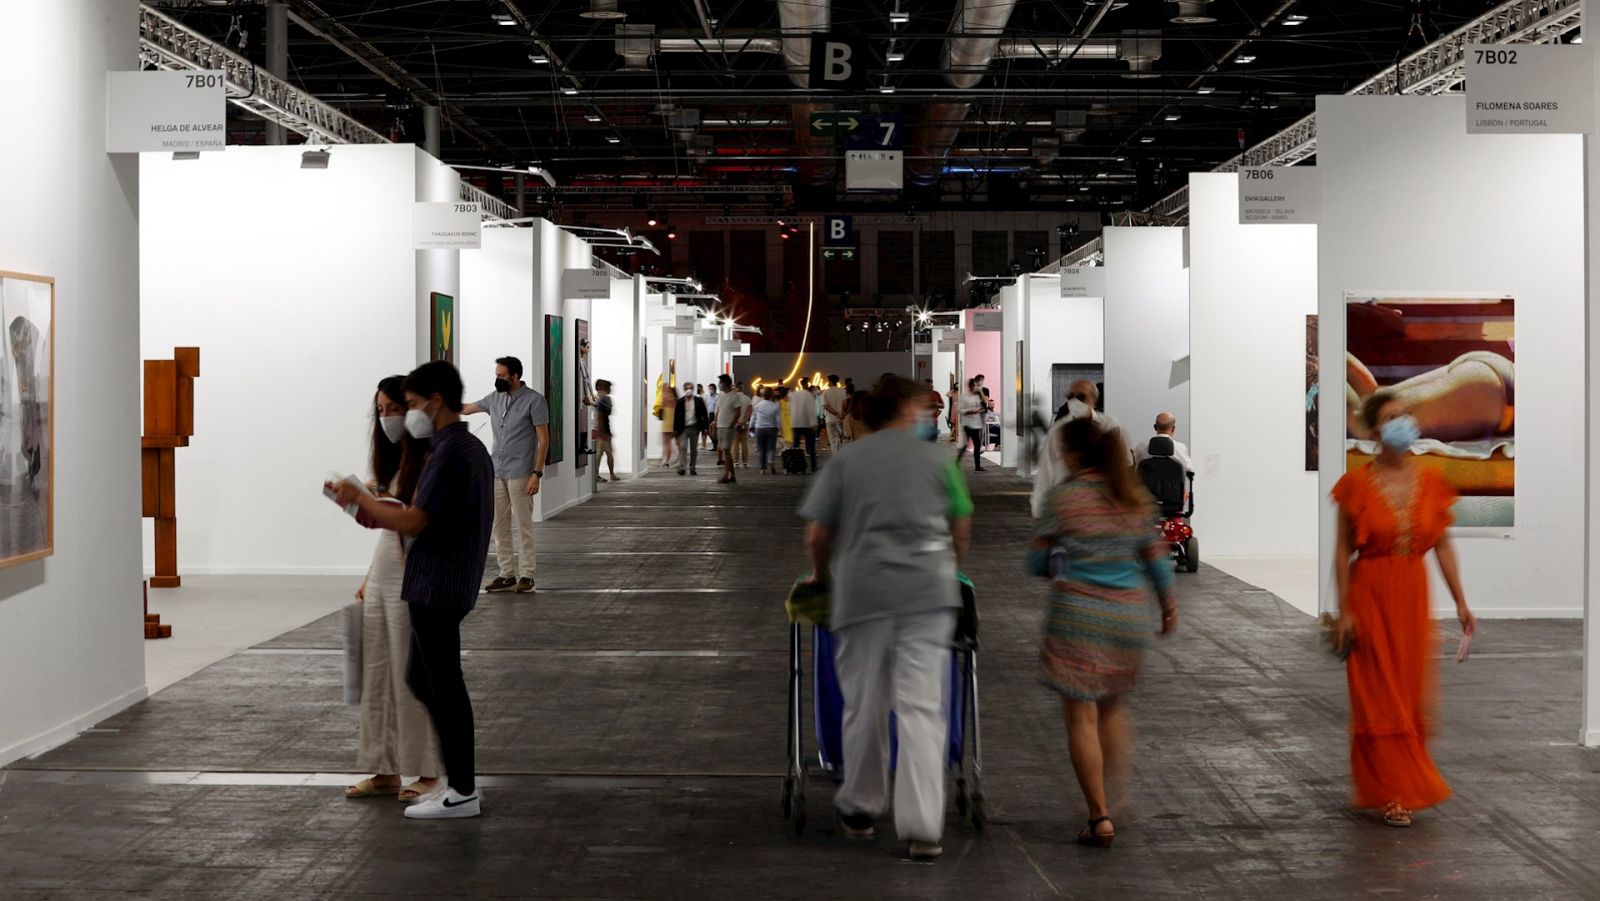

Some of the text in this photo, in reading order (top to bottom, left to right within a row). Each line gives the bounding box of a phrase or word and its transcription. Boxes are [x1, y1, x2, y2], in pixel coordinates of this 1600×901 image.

[823, 41, 852, 81] B
[1474, 50, 1517, 64] 7B02
[185, 74, 224, 88] 7B01
[1476, 102, 1558, 110] FILOMENA SOARES
[151, 124, 223, 132] HELGA DE ALVEAR
[1476, 119, 1503, 127] LISBON
[1510, 119, 1548, 127] PORTUGAL
[879, 122, 895, 146] 7
[162, 140, 189, 148] MADRID
[195, 139, 222, 148] ESPAÑA
[1245, 169, 1274, 179] 7B06
[453, 204, 477, 212] 7B03
[831, 219, 846, 239] B
